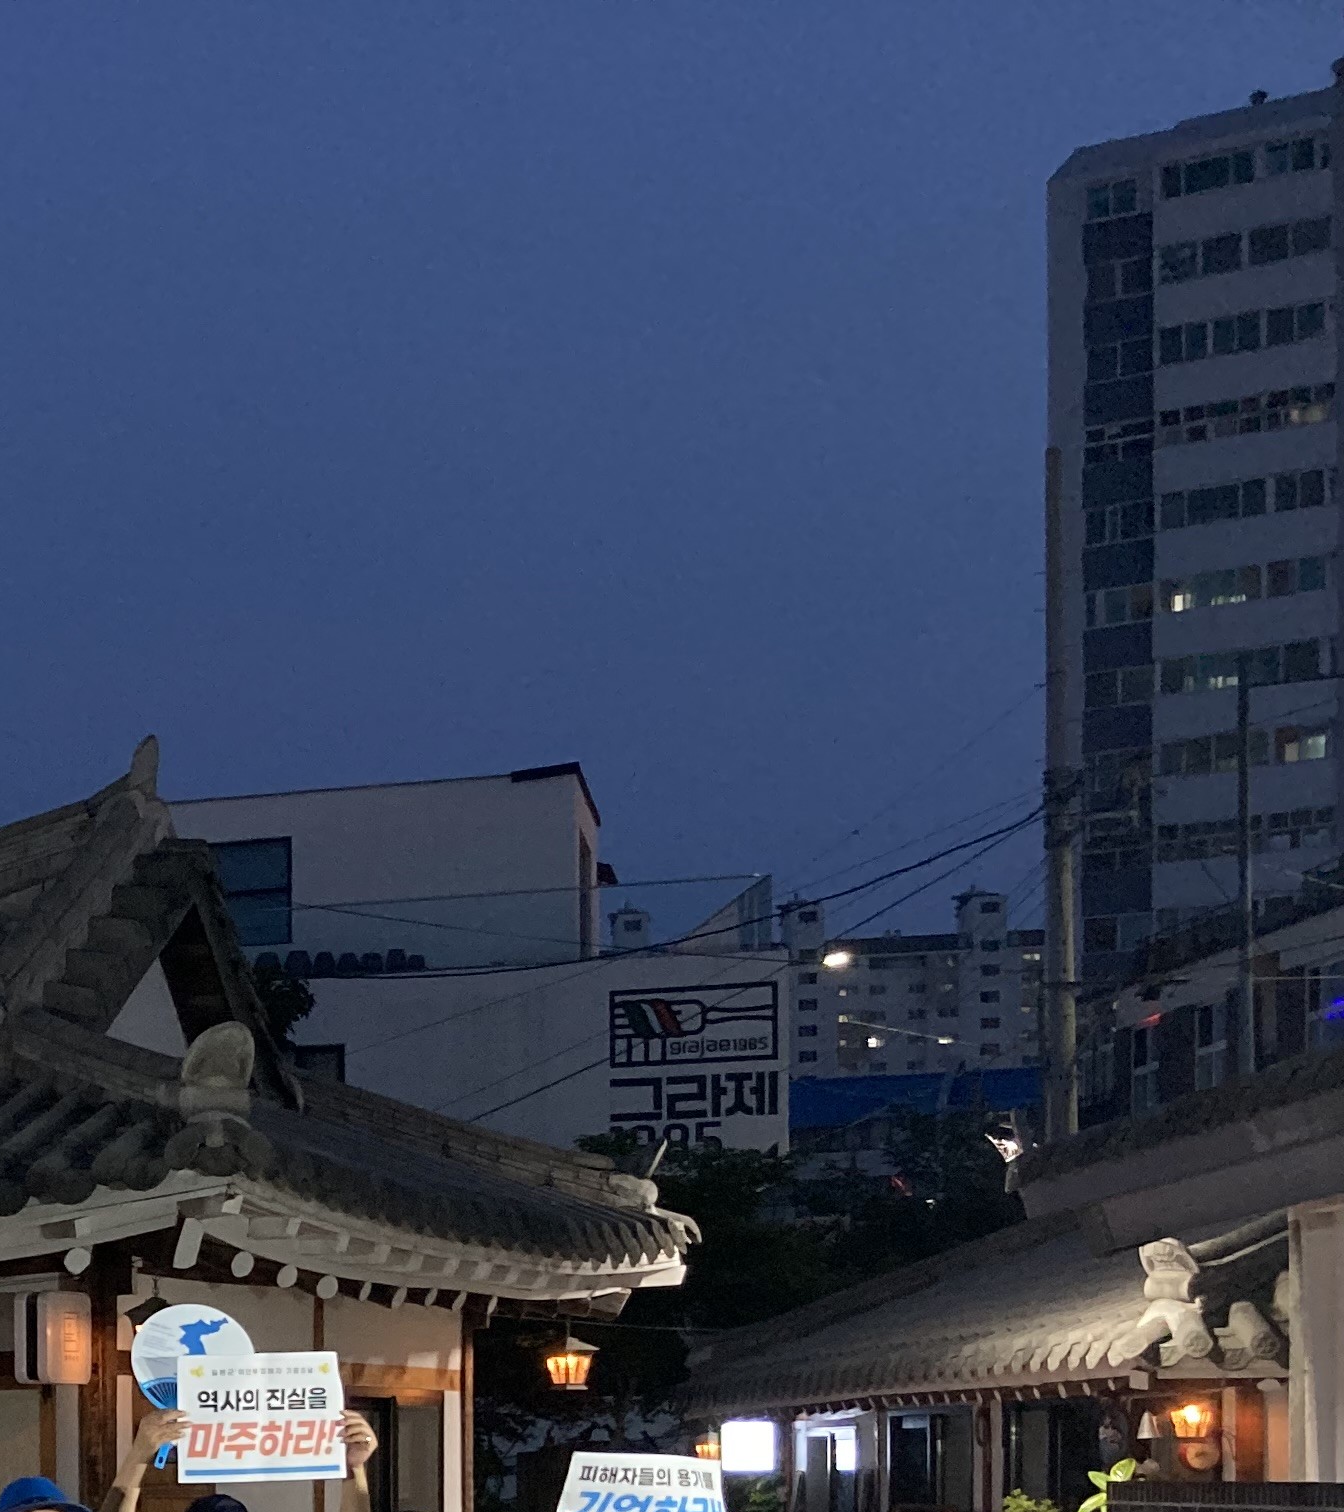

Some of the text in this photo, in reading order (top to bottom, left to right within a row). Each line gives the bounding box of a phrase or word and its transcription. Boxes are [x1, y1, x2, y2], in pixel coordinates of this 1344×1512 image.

[610, 1071, 778, 1122] 그라제
[197, 1387, 327, 1412] 역사의 진실을
[187, 1420, 340, 1459] 마주하라!
[579, 1466, 714, 1490] 피해자들의 용기를
